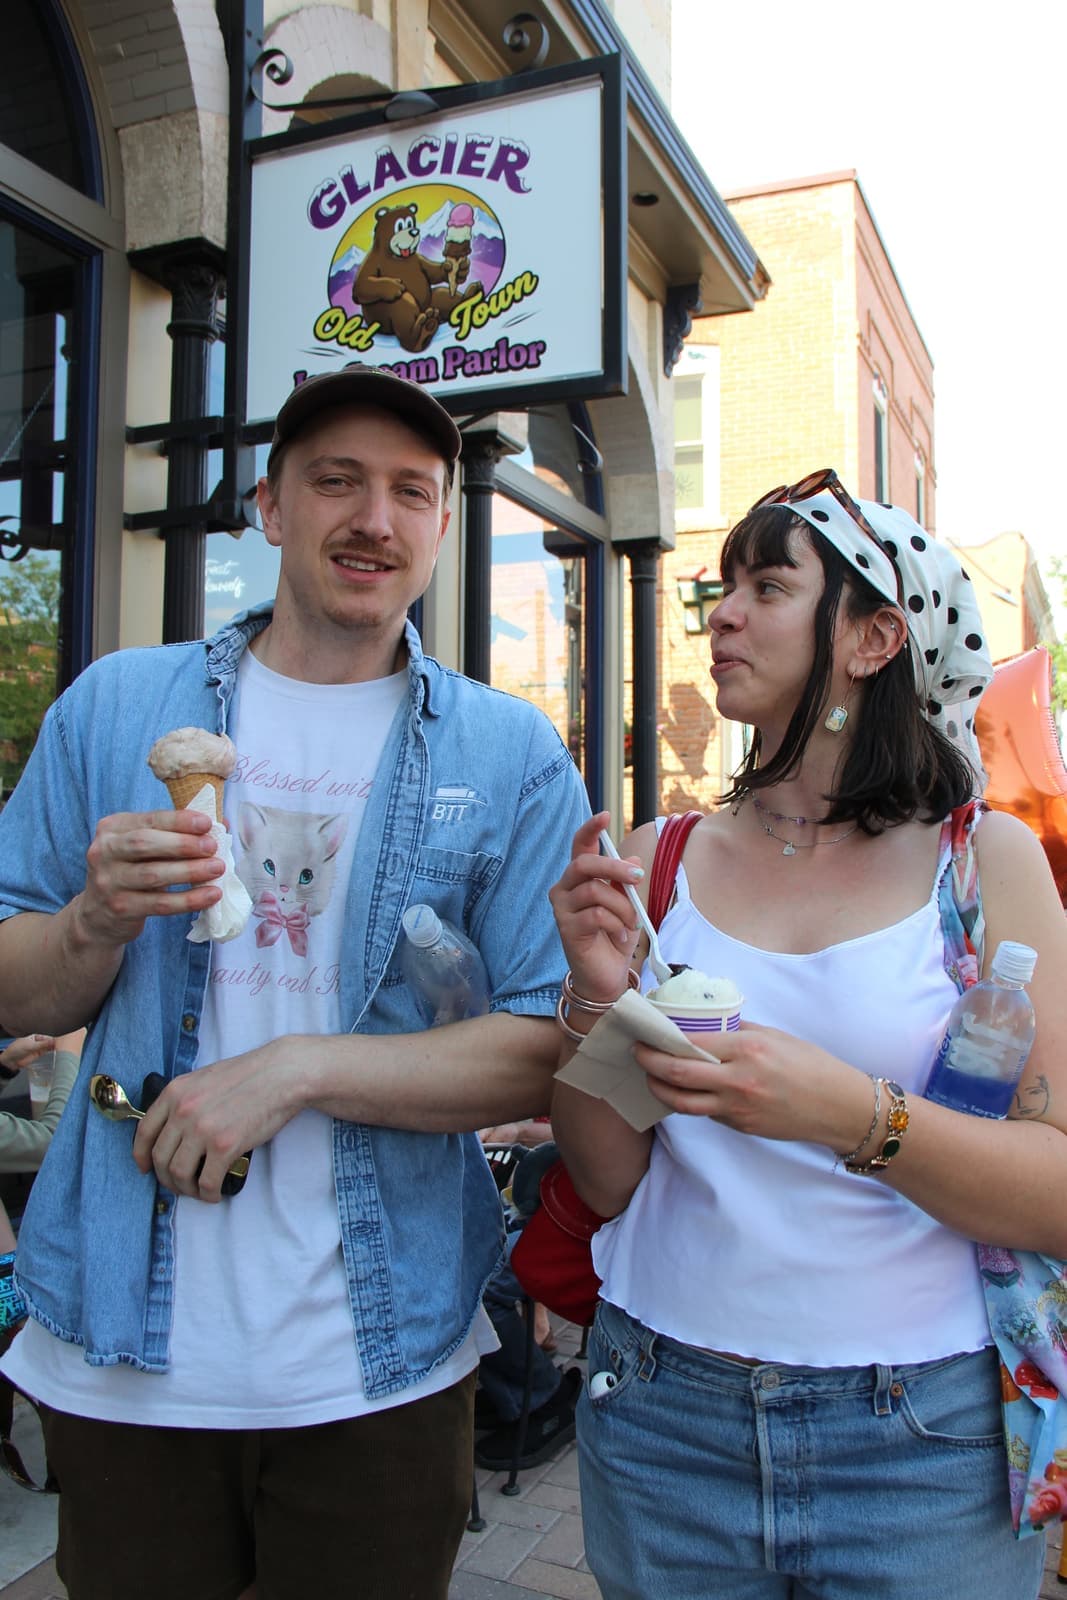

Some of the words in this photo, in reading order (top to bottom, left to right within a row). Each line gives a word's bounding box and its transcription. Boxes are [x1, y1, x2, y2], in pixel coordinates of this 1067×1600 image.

[307, 132, 532, 230] GLACIER
[313, 306, 382, 352] Old
[448, 270, 540, 341] Town
[441, 336, 547, 380] Parlor
[326, 776, 374, 799] wit
[431, 803, 468, 821] BTT
